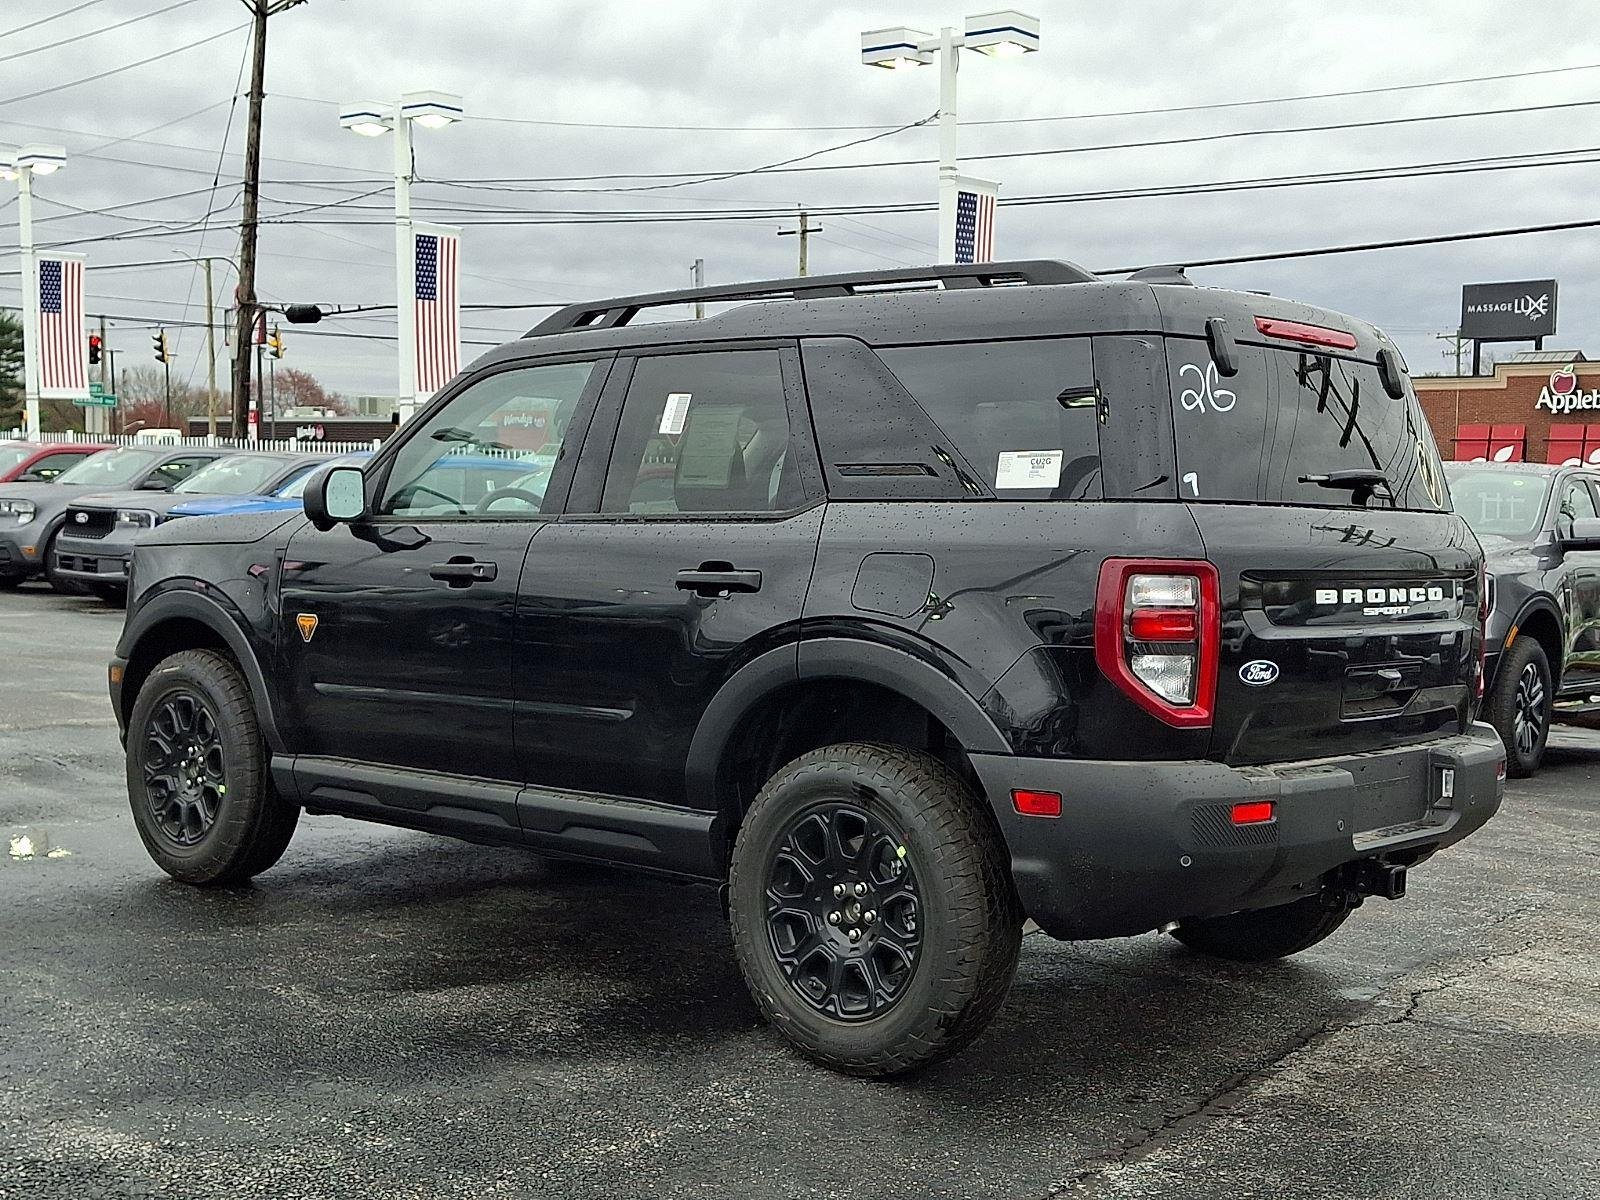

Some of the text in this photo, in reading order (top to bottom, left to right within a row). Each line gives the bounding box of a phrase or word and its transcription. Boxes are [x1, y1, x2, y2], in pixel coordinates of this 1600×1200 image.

[1467, 293, 1549, 317] MASSAGE LUXE
[1179, 360, 1237, 414] 26
[1535, 386, 1600, 414] Appleb
[1315, 587, 1443, 605] BRONCO
[1363, 605, 1411, 616] SPORT
[1247, 663, 1273, 681] Ford
